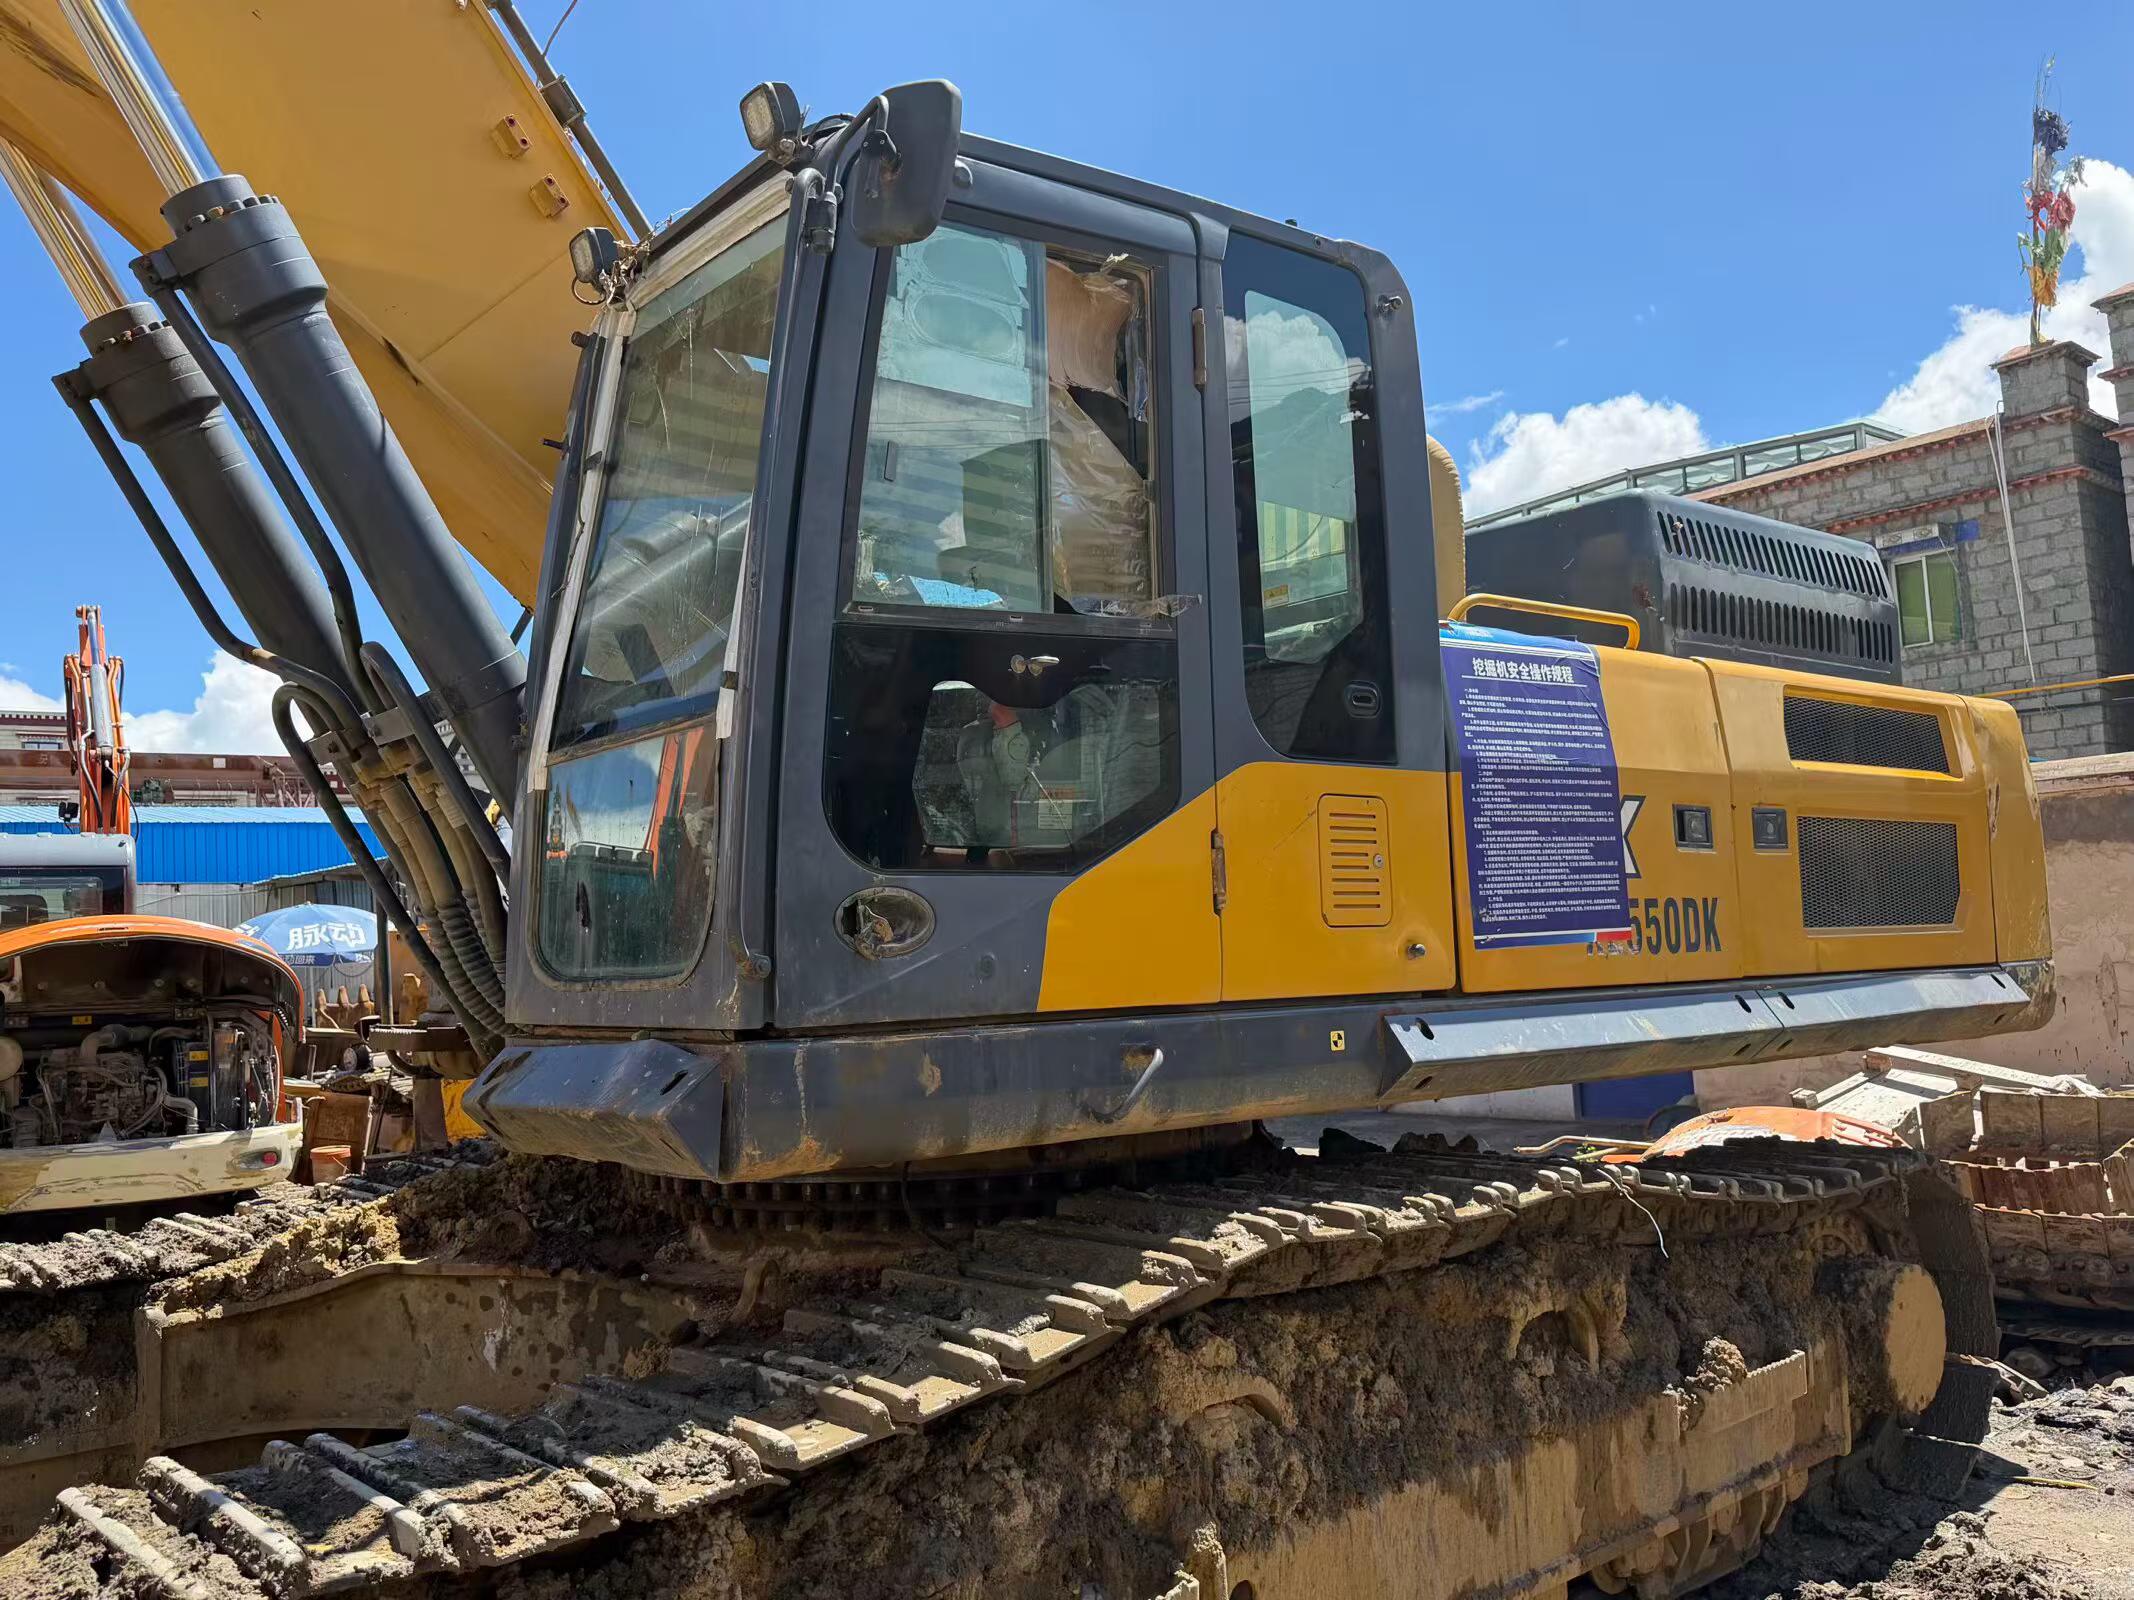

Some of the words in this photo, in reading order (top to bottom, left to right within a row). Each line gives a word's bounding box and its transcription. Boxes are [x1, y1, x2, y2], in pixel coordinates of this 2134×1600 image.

[1472, 657, 1575, 683] 挖掘机安全操作规程
[286, 921, 367, 951] 脉动
[1586, 896, 1722, 956] 550DK
